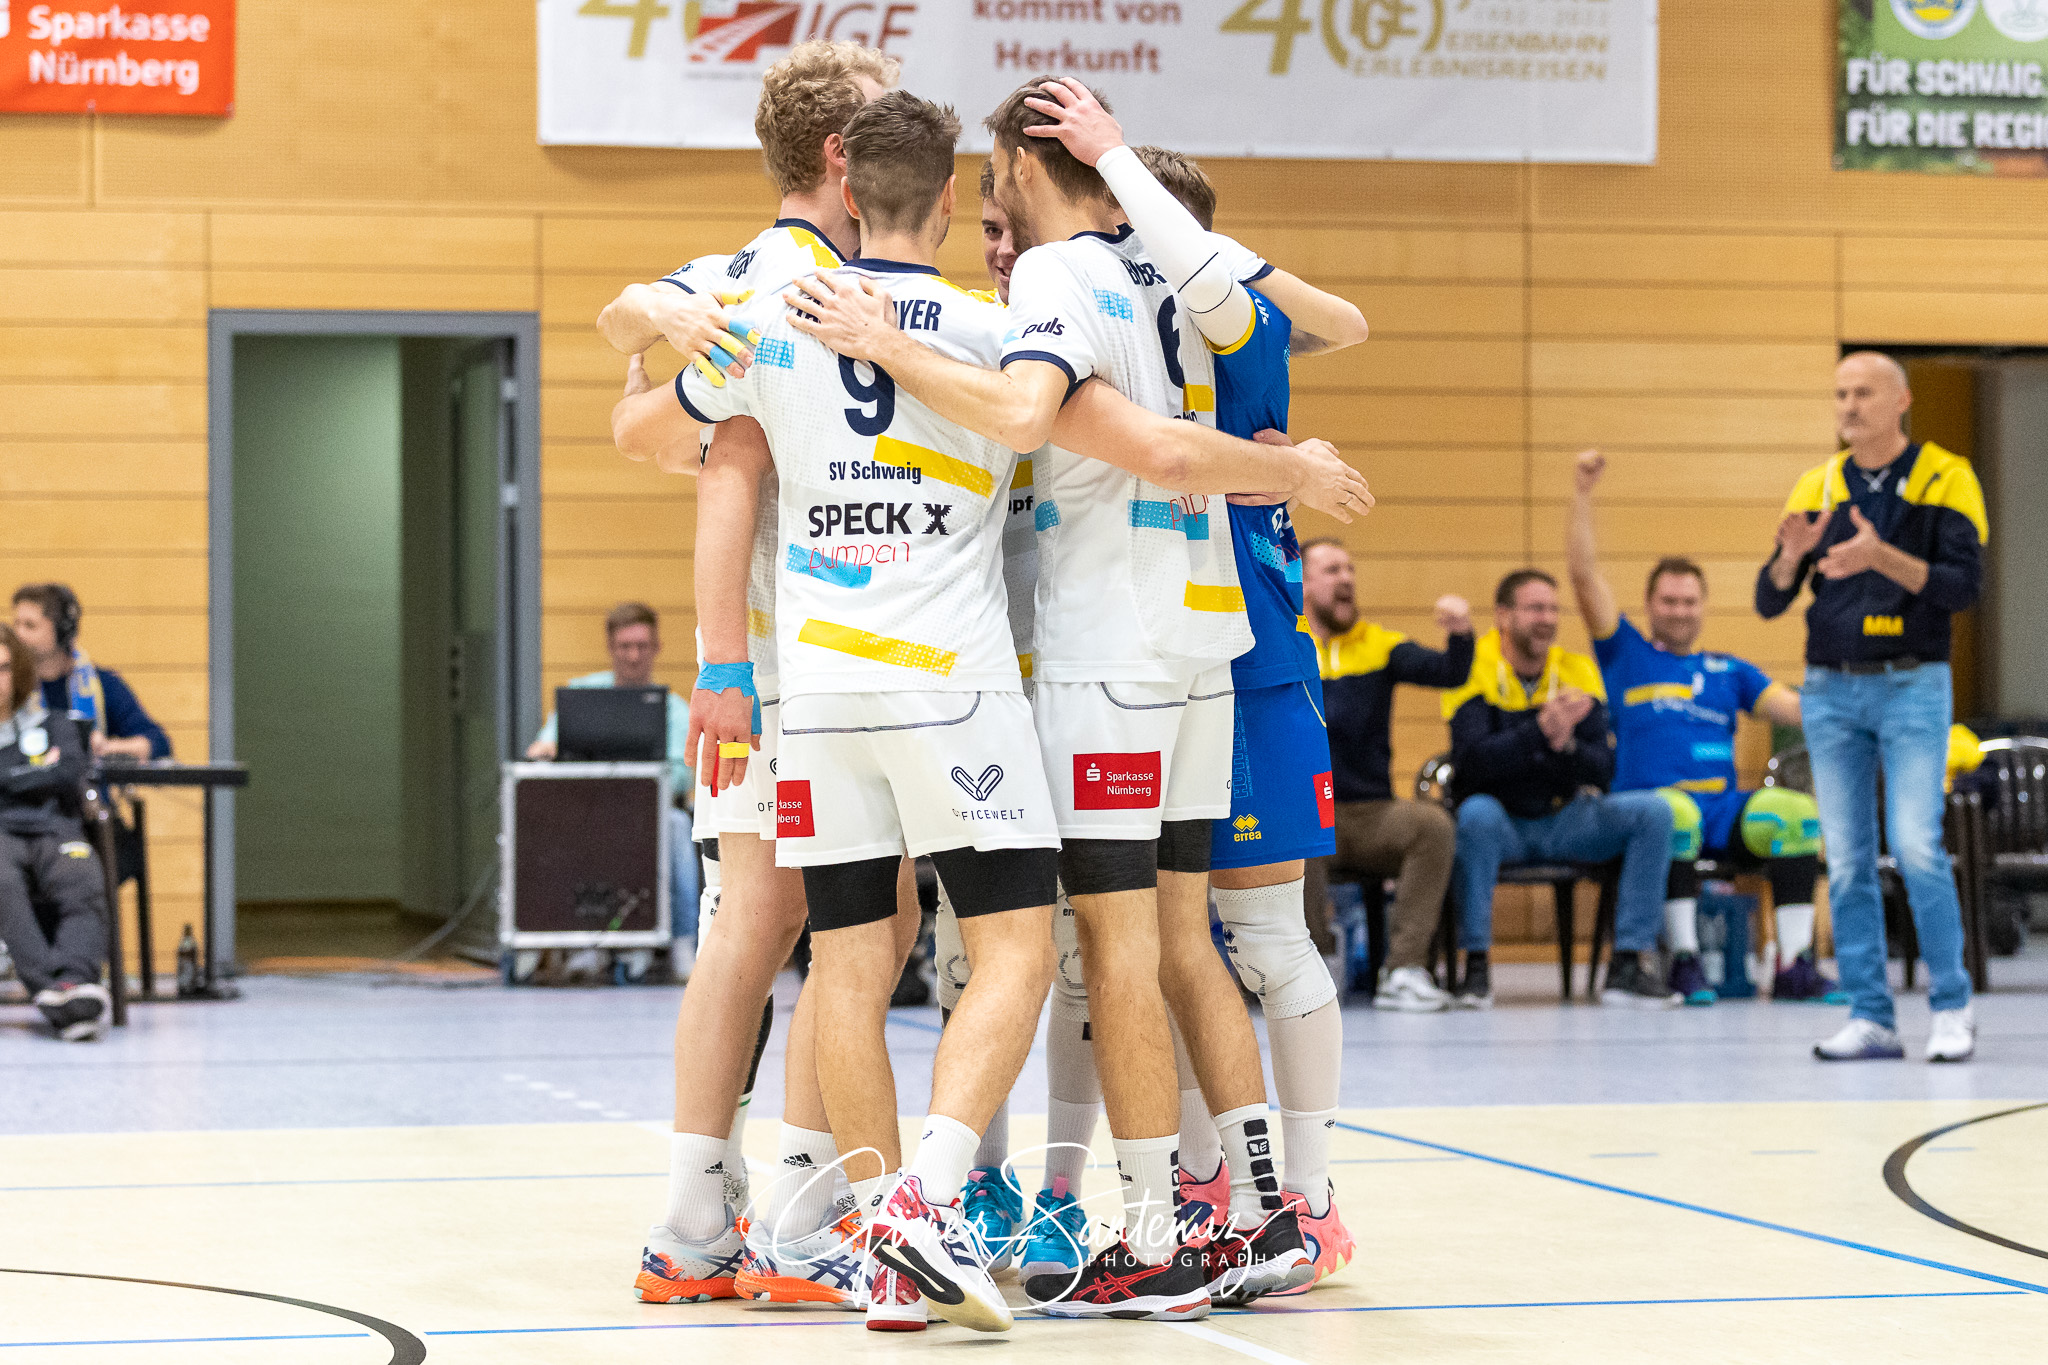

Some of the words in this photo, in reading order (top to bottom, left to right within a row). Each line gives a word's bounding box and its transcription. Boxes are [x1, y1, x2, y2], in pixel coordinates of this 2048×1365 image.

[27, 4, 210, 46] Sparkasse
[974, 0, 1106, 21] kommt
[1114, 2, 1182, 24] von
[29, 49, 200, 95] Nürnberg
[995, 40, 1160, 73] Herkunft
[1847, 51, 1911, 96] FÜR
[1847, 101, 1912, 147] FÜR
[1916, 108, 1968, 148] DIE
[1021, 317, 1065, 339] puls
[838, 353, 896, 436] 9
[829, 461, 846, 481] SV
[851, 460, 922, 485] Schwaig
[808, 502, 913, 538] SPECK
[809, 541, 910, 576] pumpen
[1863, 615, 1904, 636] MM
[1106, 771, 1154, 783] Sparkasse
[1106, 785, 1152, 797] Nürnberg
[1234, 831, 1262, 842] errea
